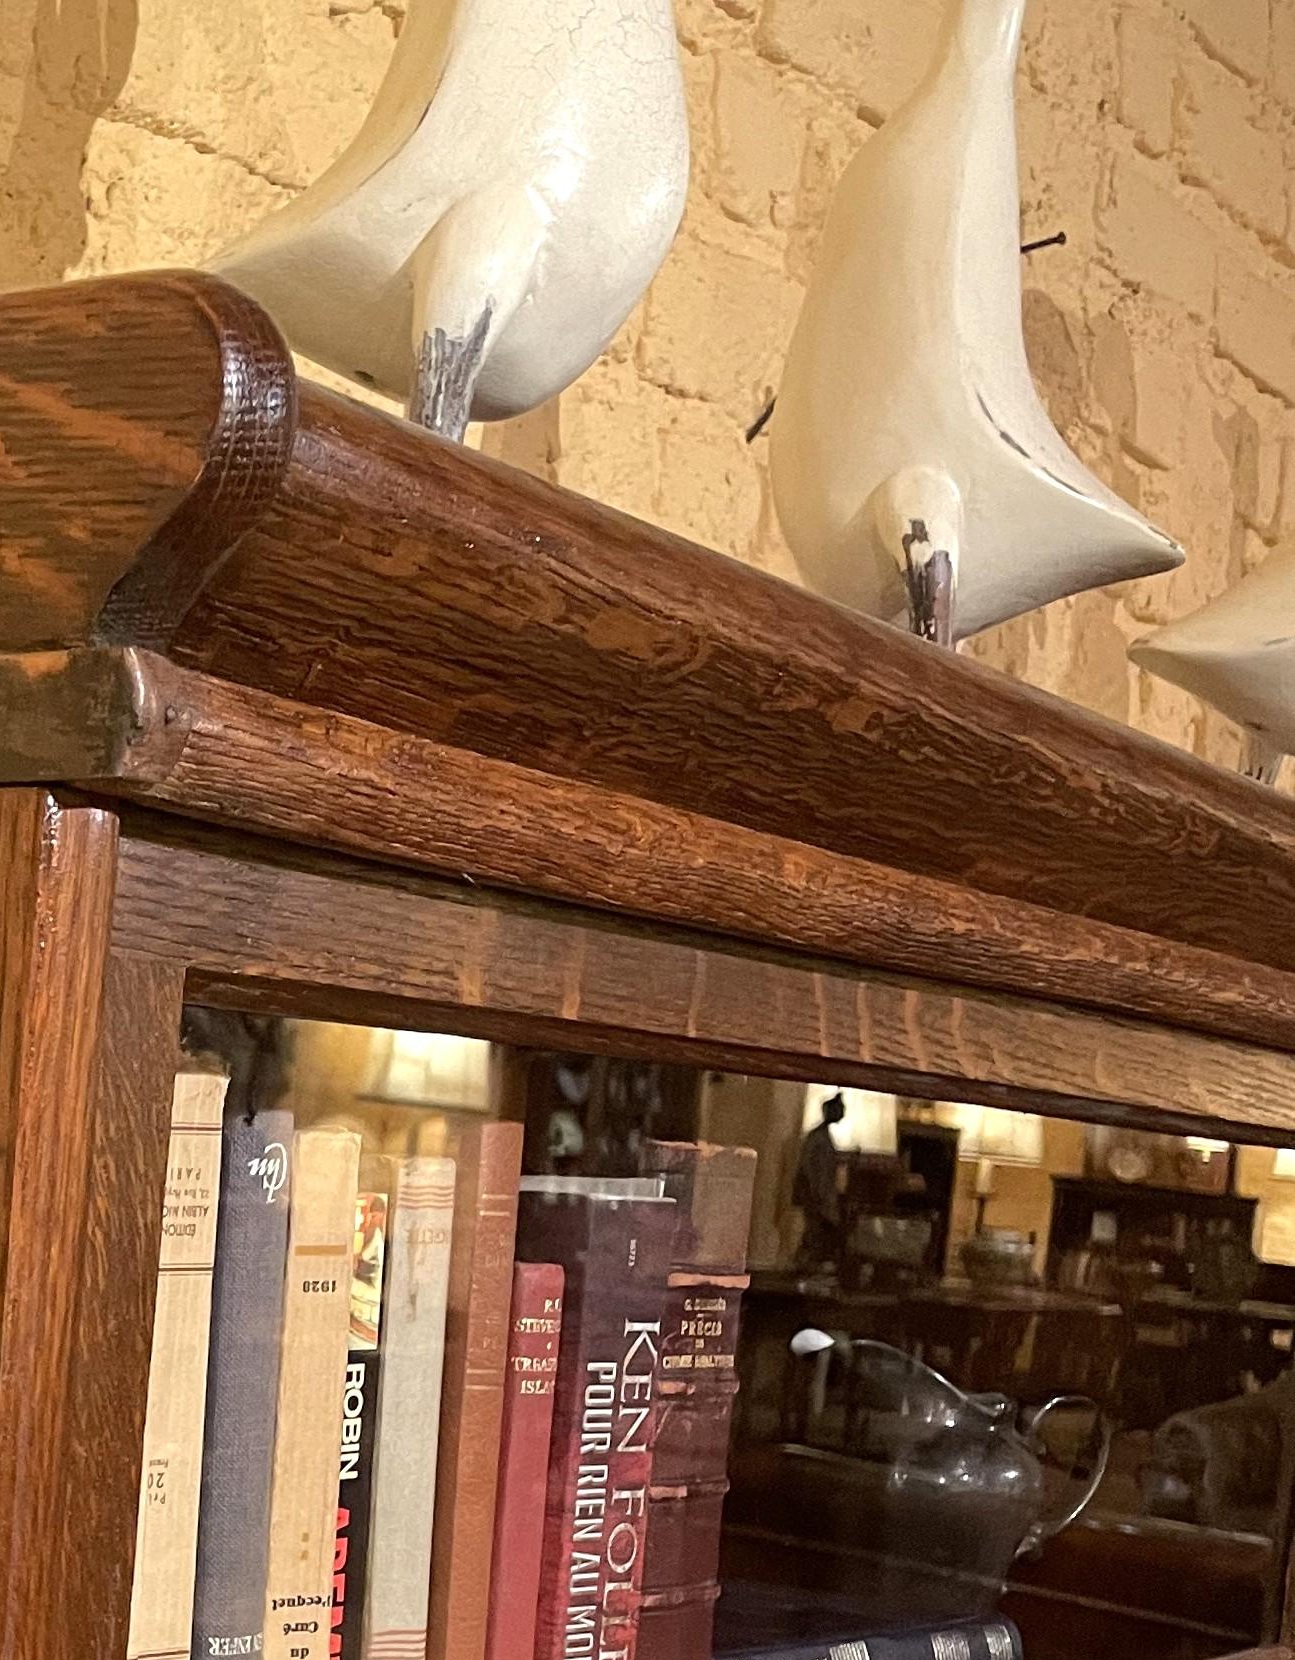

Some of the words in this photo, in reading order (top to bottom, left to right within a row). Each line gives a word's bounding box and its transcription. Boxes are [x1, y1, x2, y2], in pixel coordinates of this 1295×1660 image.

[170, 1168, 202, 1180] PARI
[579, 1361, 618, 1453] POUR
[615, 1317, 661, 1451] KEN
[339, 1362, 367, 1481] ROBIN
[572, 1465, 608, 1541] RIEN
[568, 1552, 602, 1594] AU
[283, 1621, 319, 1636] Curé
[290, 1647, 309, 1659] du
